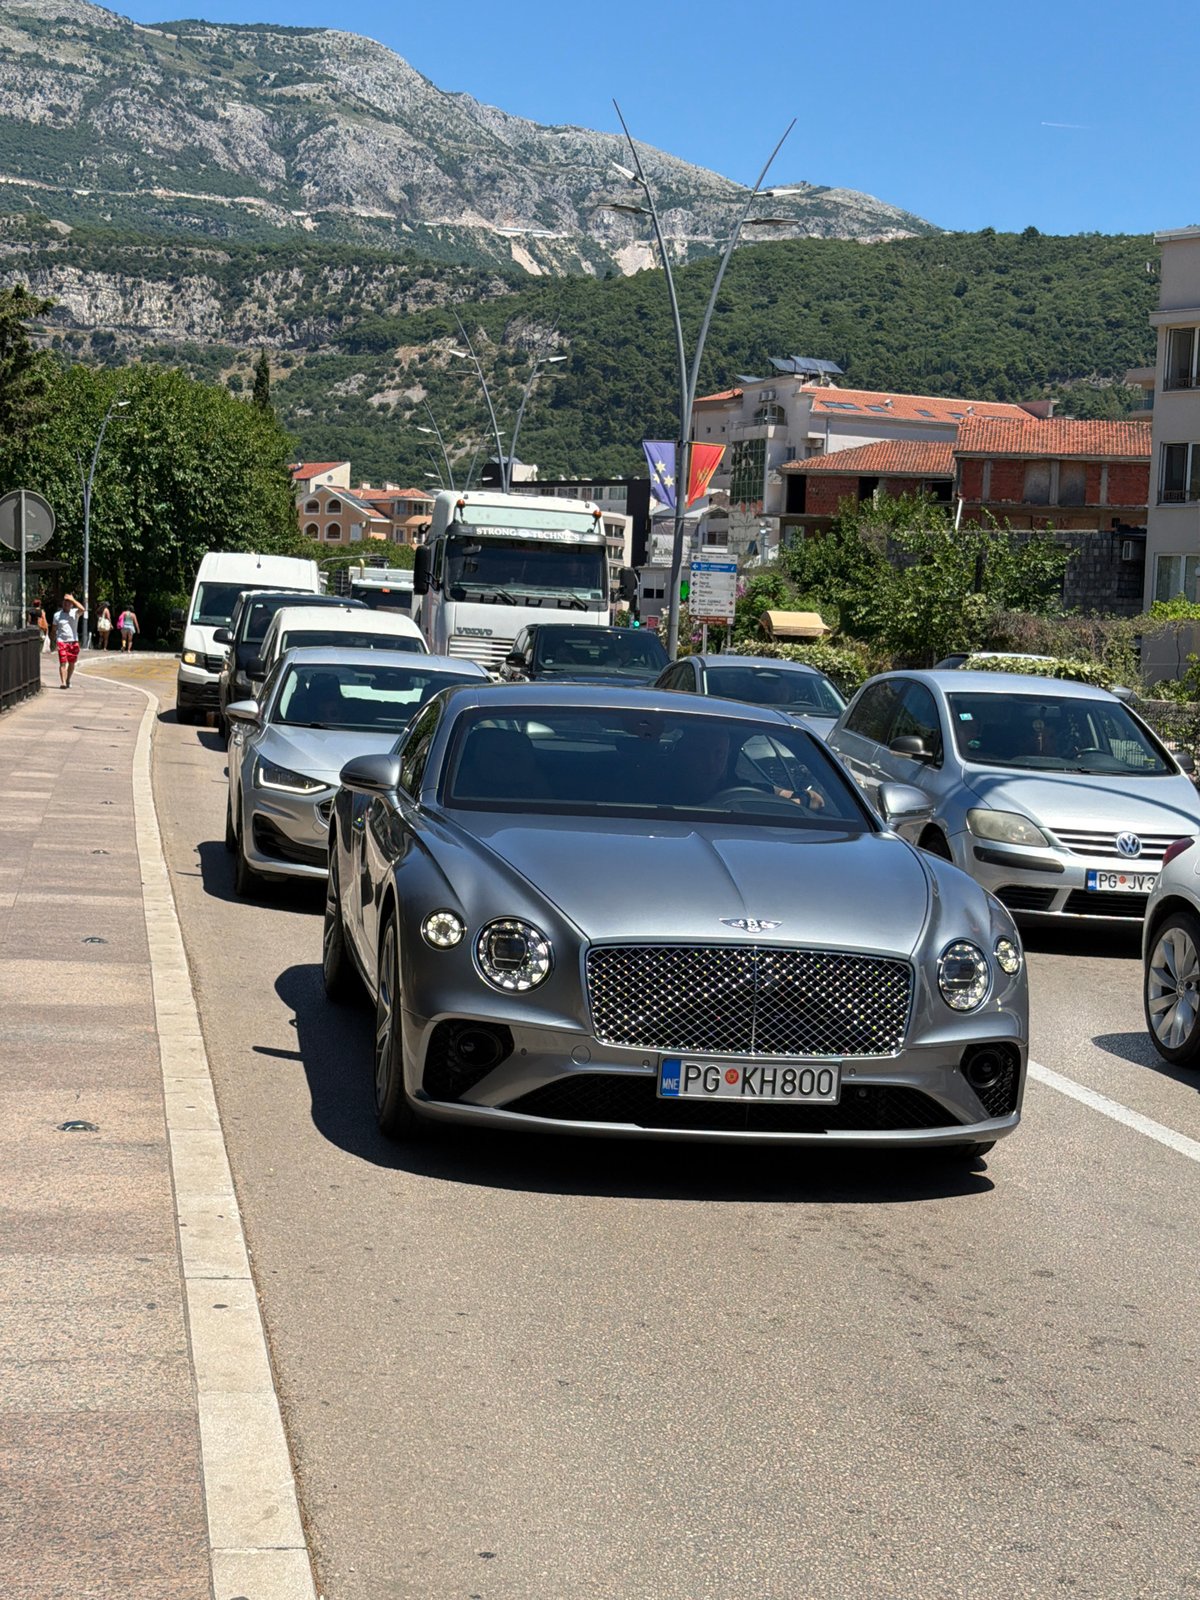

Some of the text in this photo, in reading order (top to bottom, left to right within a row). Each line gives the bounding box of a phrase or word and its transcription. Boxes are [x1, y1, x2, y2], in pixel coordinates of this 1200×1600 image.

[476, 527, 517, 537] STRONG
[456, 626, 493, 636] VOLVO
[1098, 873, 1117, 889] PG
[1127, 875, 1156, 891] JV3
[662, 1078, 680, 1091] MNE
[684, 1064, 833, 1096] PG KH800
